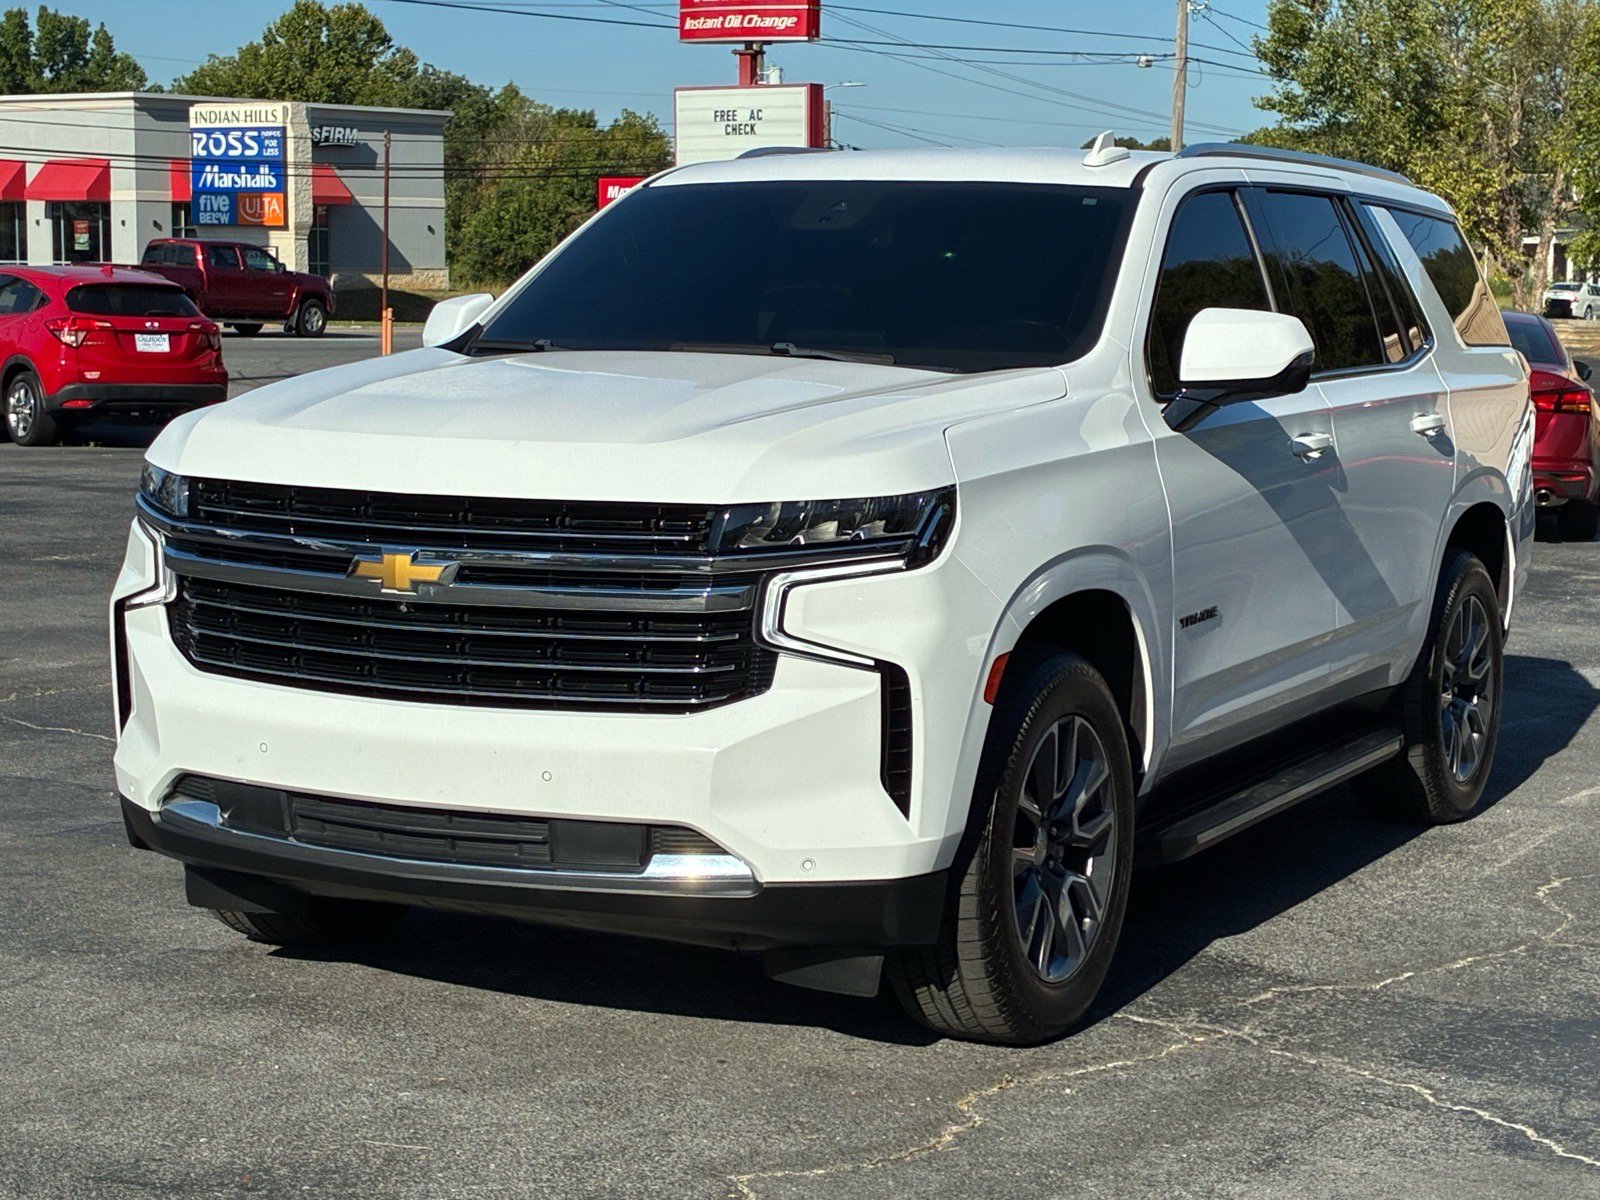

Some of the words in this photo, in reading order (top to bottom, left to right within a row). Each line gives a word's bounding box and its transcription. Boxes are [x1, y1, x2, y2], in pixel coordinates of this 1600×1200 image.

[684, 16, 724, 30] Instant
[724, 14, 743, 28] Oil
[742, 14, 798, 30] Change
[194, 110, 240, 124] INDIAN
[244, 109, 277, 122] HILLS
[714, 110, 738, 122] FREE
[749, 109, 762, 121] AC
[725, 123, 756, 136] CHECK
[192, 131, 258, 156] ROSS
[198, 164, 276, 188] Marshalls
[199, 194, 230, 212] five
[246, 198, 280, 214] ULTA
[199, 212, 230, 224] BELOW
